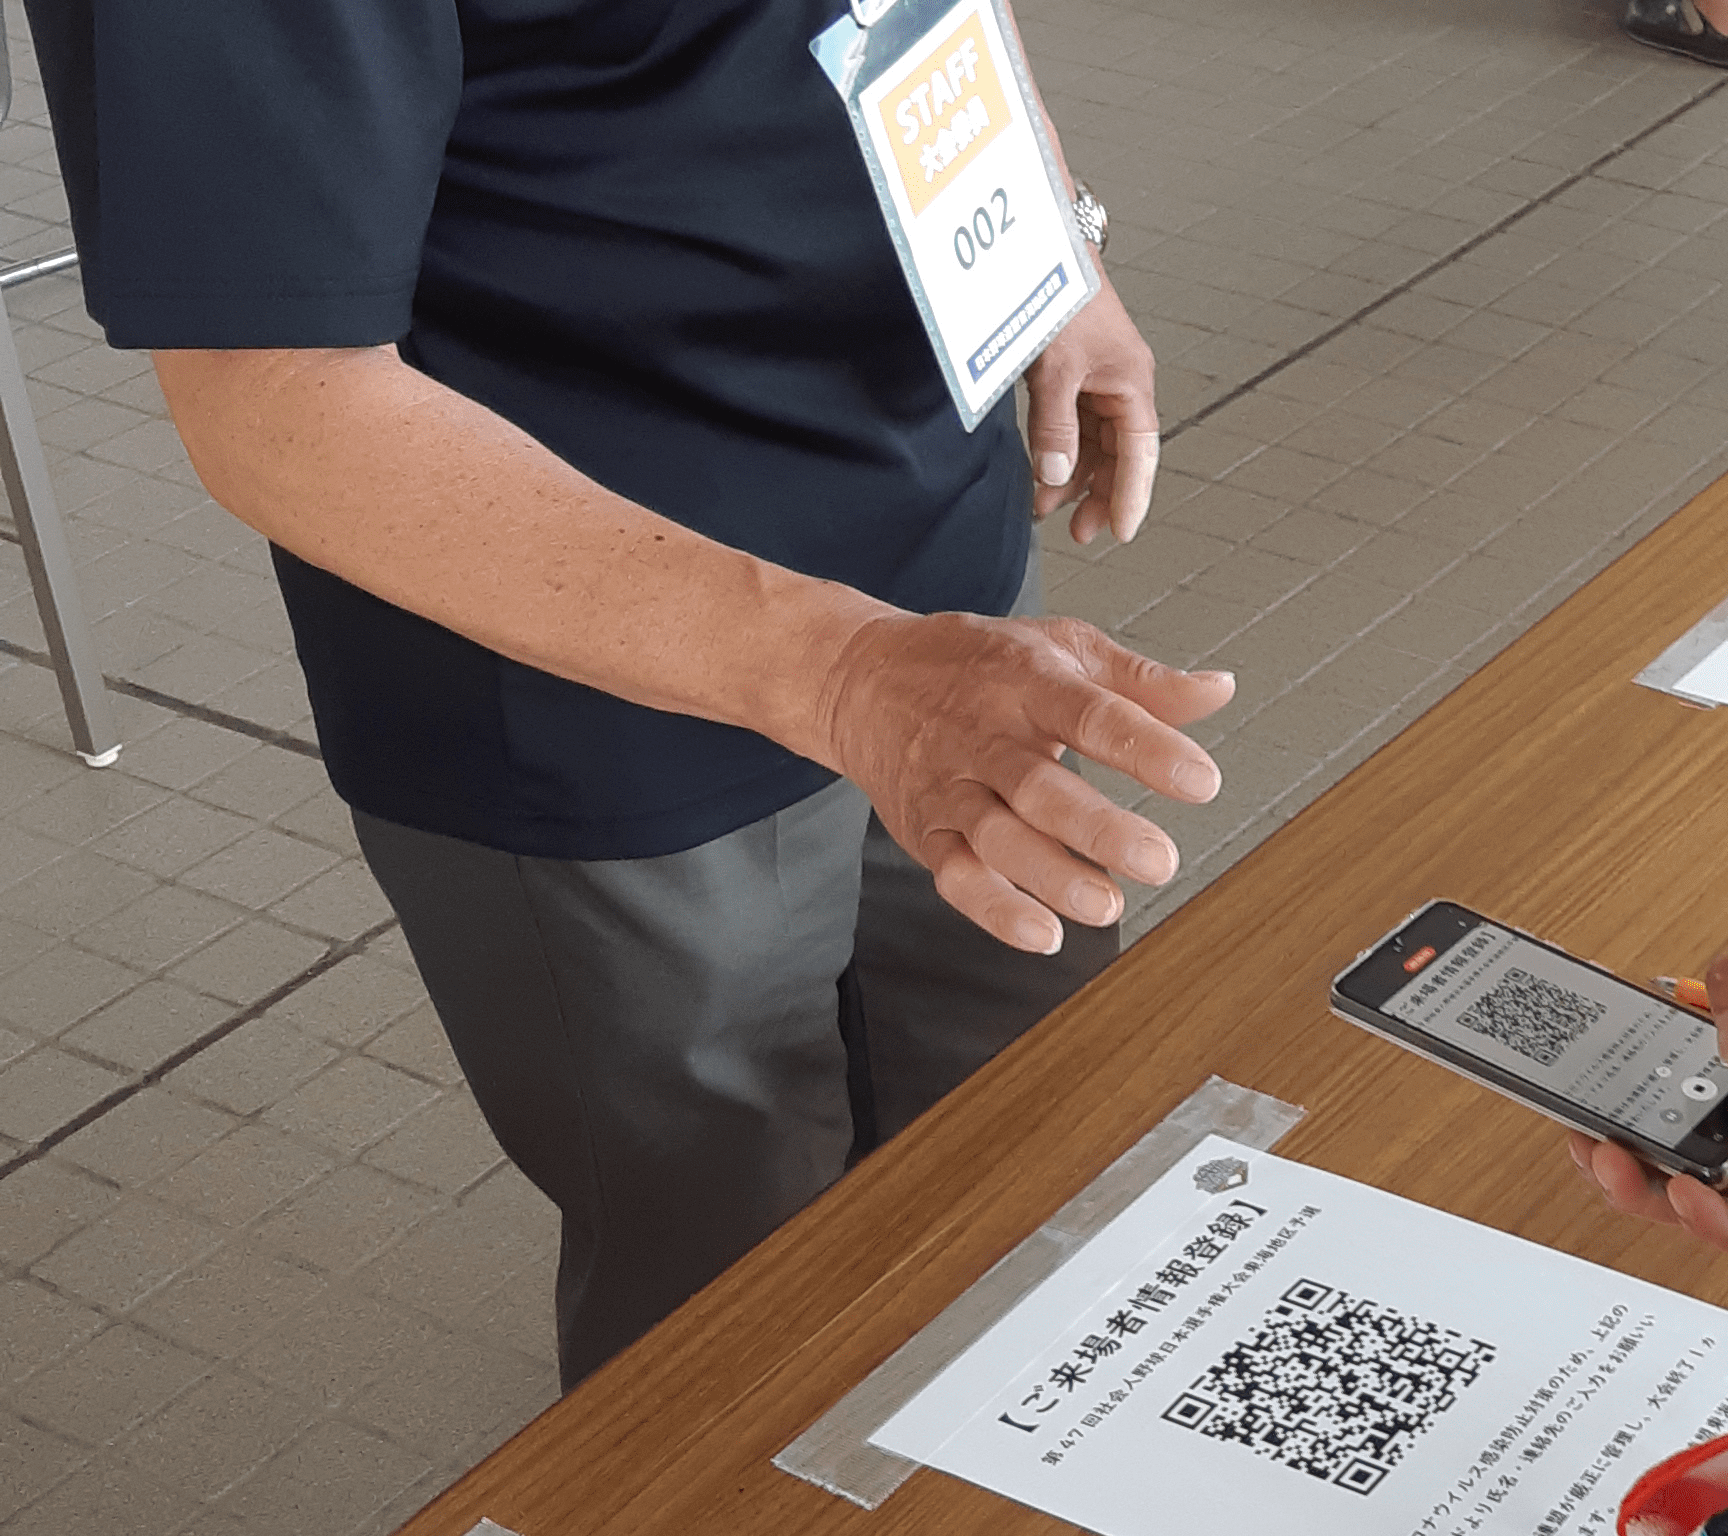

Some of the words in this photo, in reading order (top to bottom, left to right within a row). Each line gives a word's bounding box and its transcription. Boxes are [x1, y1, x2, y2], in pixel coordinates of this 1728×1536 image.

[894, 37, 981, 147] STAFF
[954, 188, 1015, 270] 002
[998, 1200, 1267, 1433] 【ご来場者情報登録】
